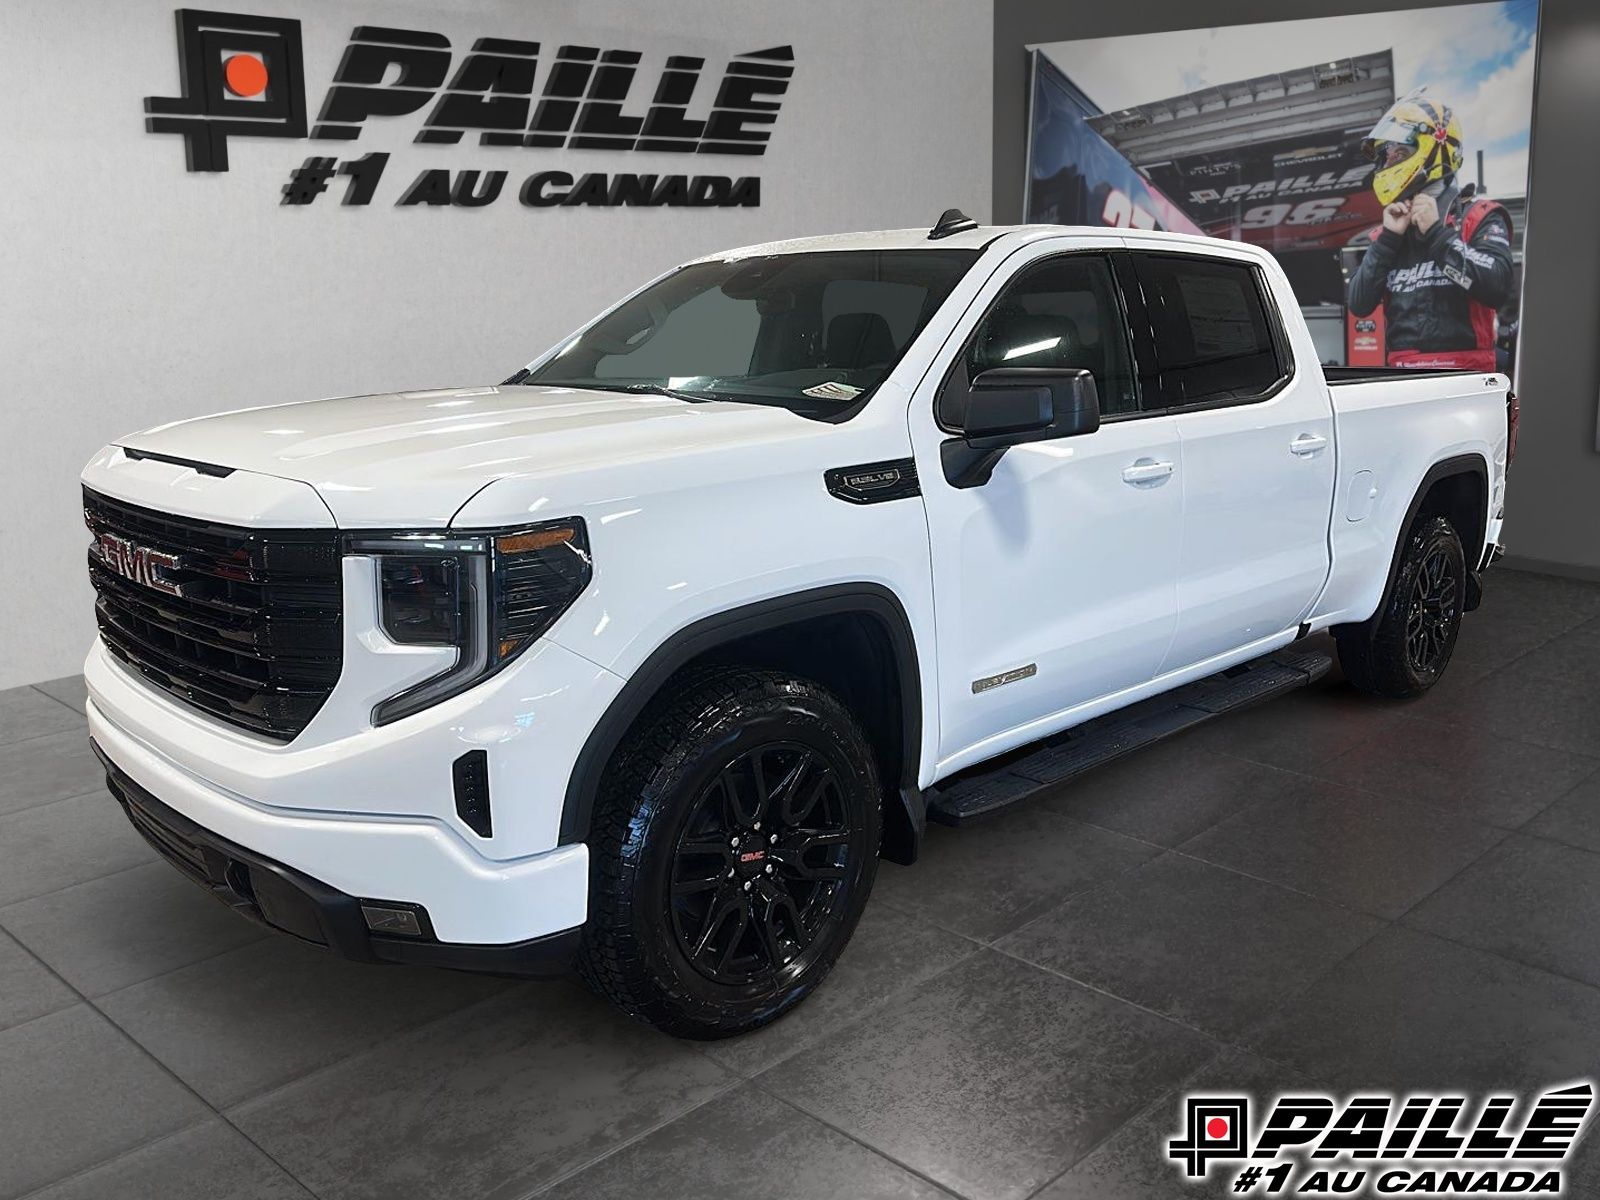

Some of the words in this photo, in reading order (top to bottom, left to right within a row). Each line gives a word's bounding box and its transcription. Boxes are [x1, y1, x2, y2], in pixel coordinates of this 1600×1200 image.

[309, 25, 795, 156] PAILLÉ
[280, 152, 391, 207] #1
[395, 169, 509, 207] AU
[518, 170, 761, 208] CANADA
[1240, 196, 1347, 230] 96
[100, 532, 184, 598] GMC
[740, 849, 766, 862] GMC
